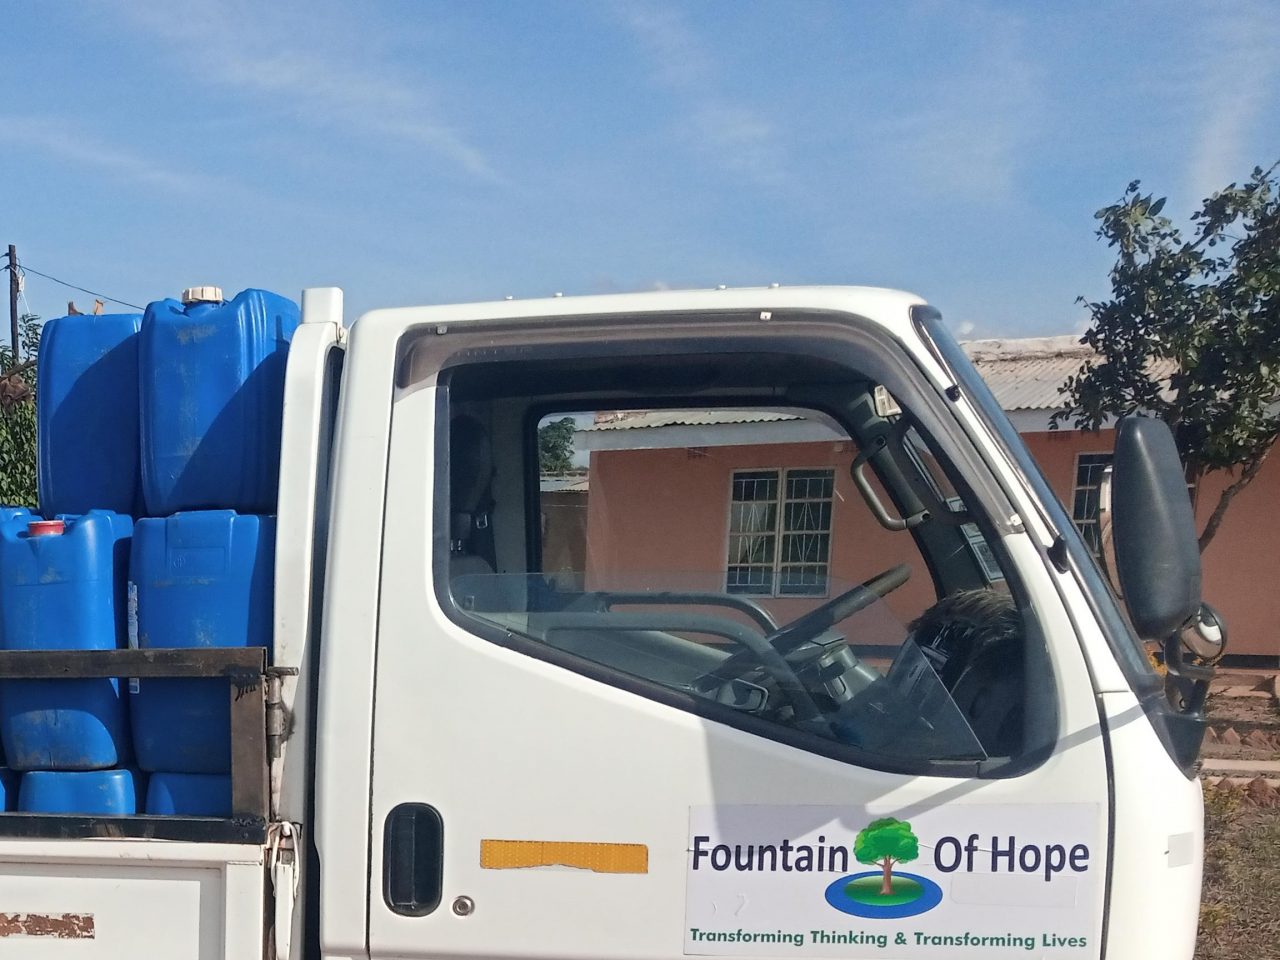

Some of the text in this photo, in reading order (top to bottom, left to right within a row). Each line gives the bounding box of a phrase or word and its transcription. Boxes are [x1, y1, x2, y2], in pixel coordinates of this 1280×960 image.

[692, 833, 1090, 882] Fountain Of Hope
[690, 928, 1088, 950] Transforming Thinking & Transforming Lives
